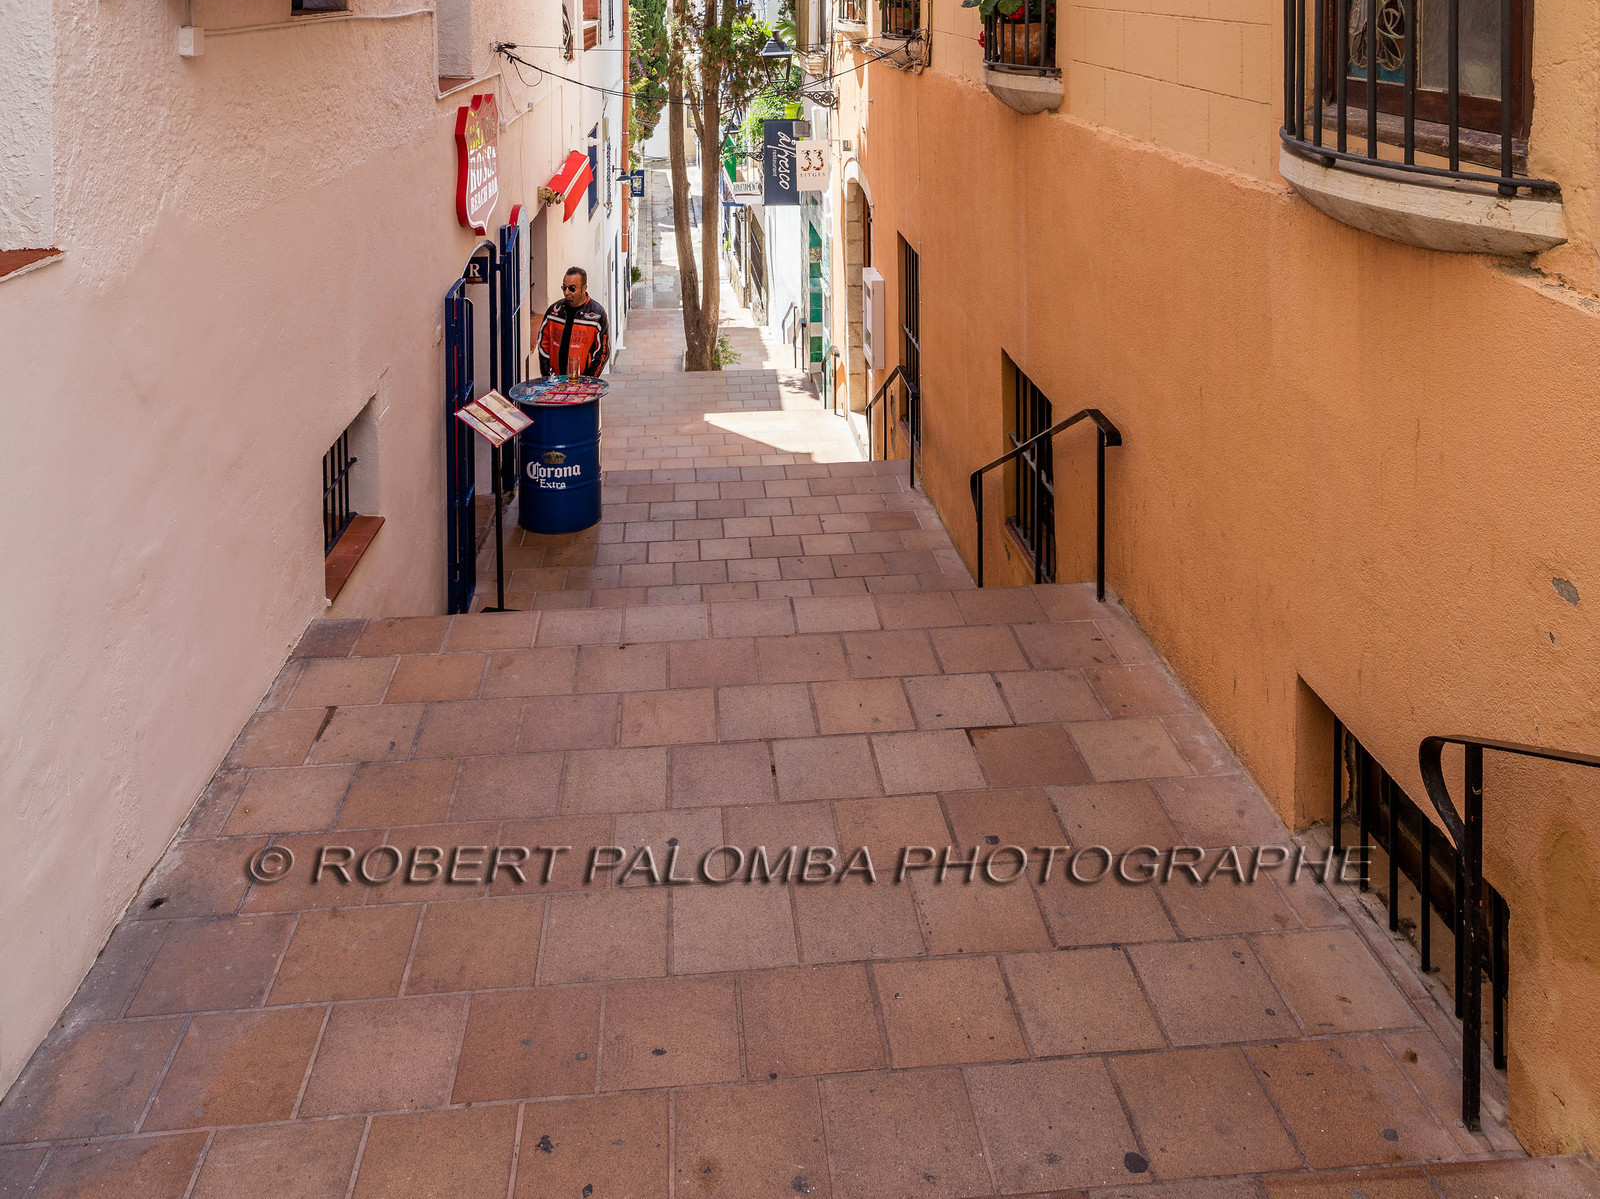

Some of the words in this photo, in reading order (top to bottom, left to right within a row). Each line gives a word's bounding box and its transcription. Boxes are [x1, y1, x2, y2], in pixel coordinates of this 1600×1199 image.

[801, 149, 824, 171] 33
[470, 182, 487, 215] BEACH
[488, 177, 498, 200] BAR
[469, 263, 480, 278] R
[526, 461, 582, 482] Corona
[539, 478, 567, 489] Extra
